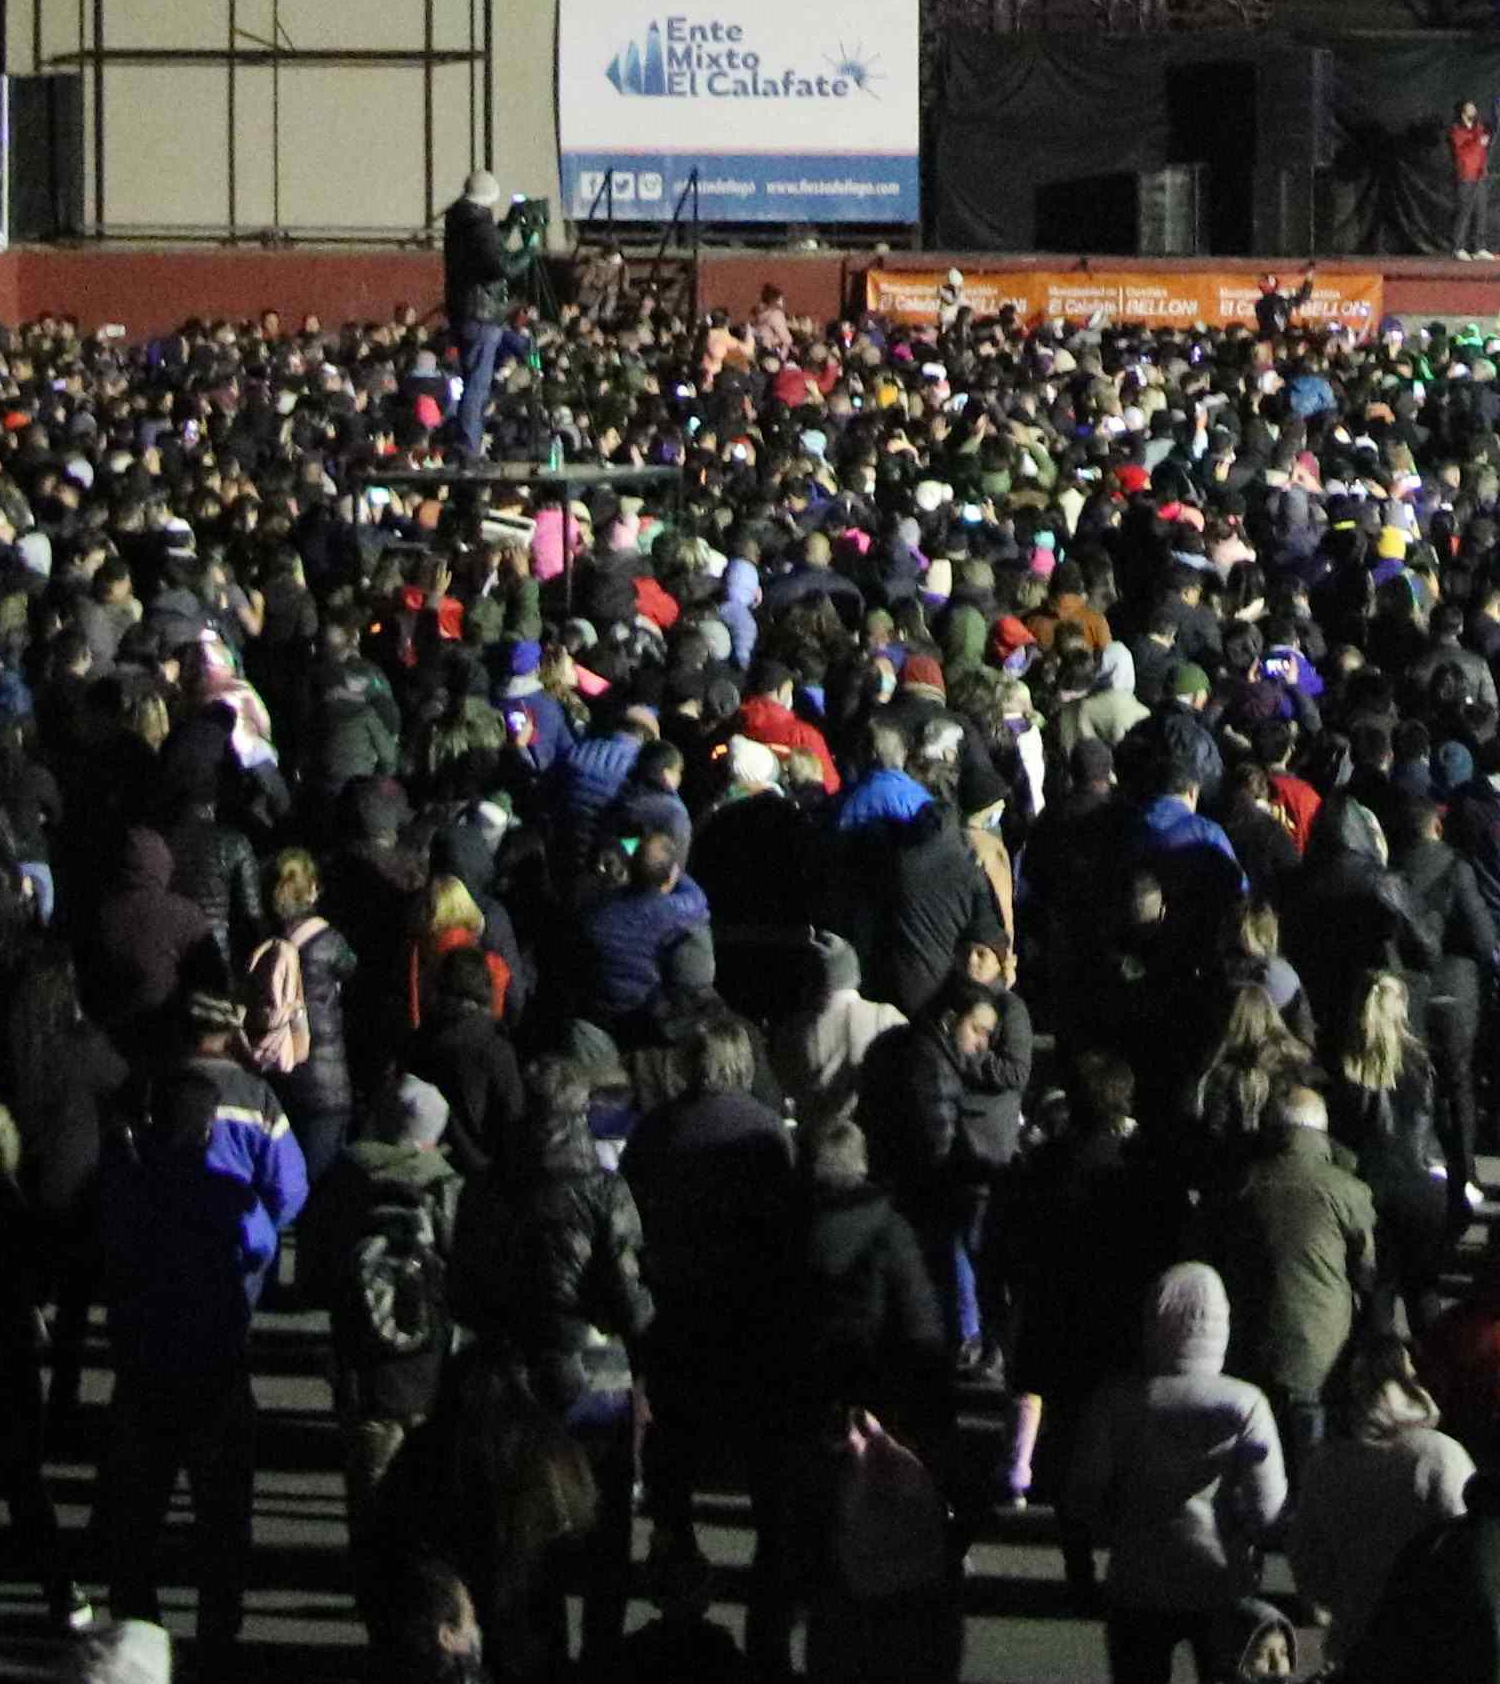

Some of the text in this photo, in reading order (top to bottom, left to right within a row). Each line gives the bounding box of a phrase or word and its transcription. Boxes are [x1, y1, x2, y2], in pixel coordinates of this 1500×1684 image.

[666, 15, 744, 44] Ente
[666, 42, 760, 71] Mixto
[667, 69, 851, 99] El Calafate
